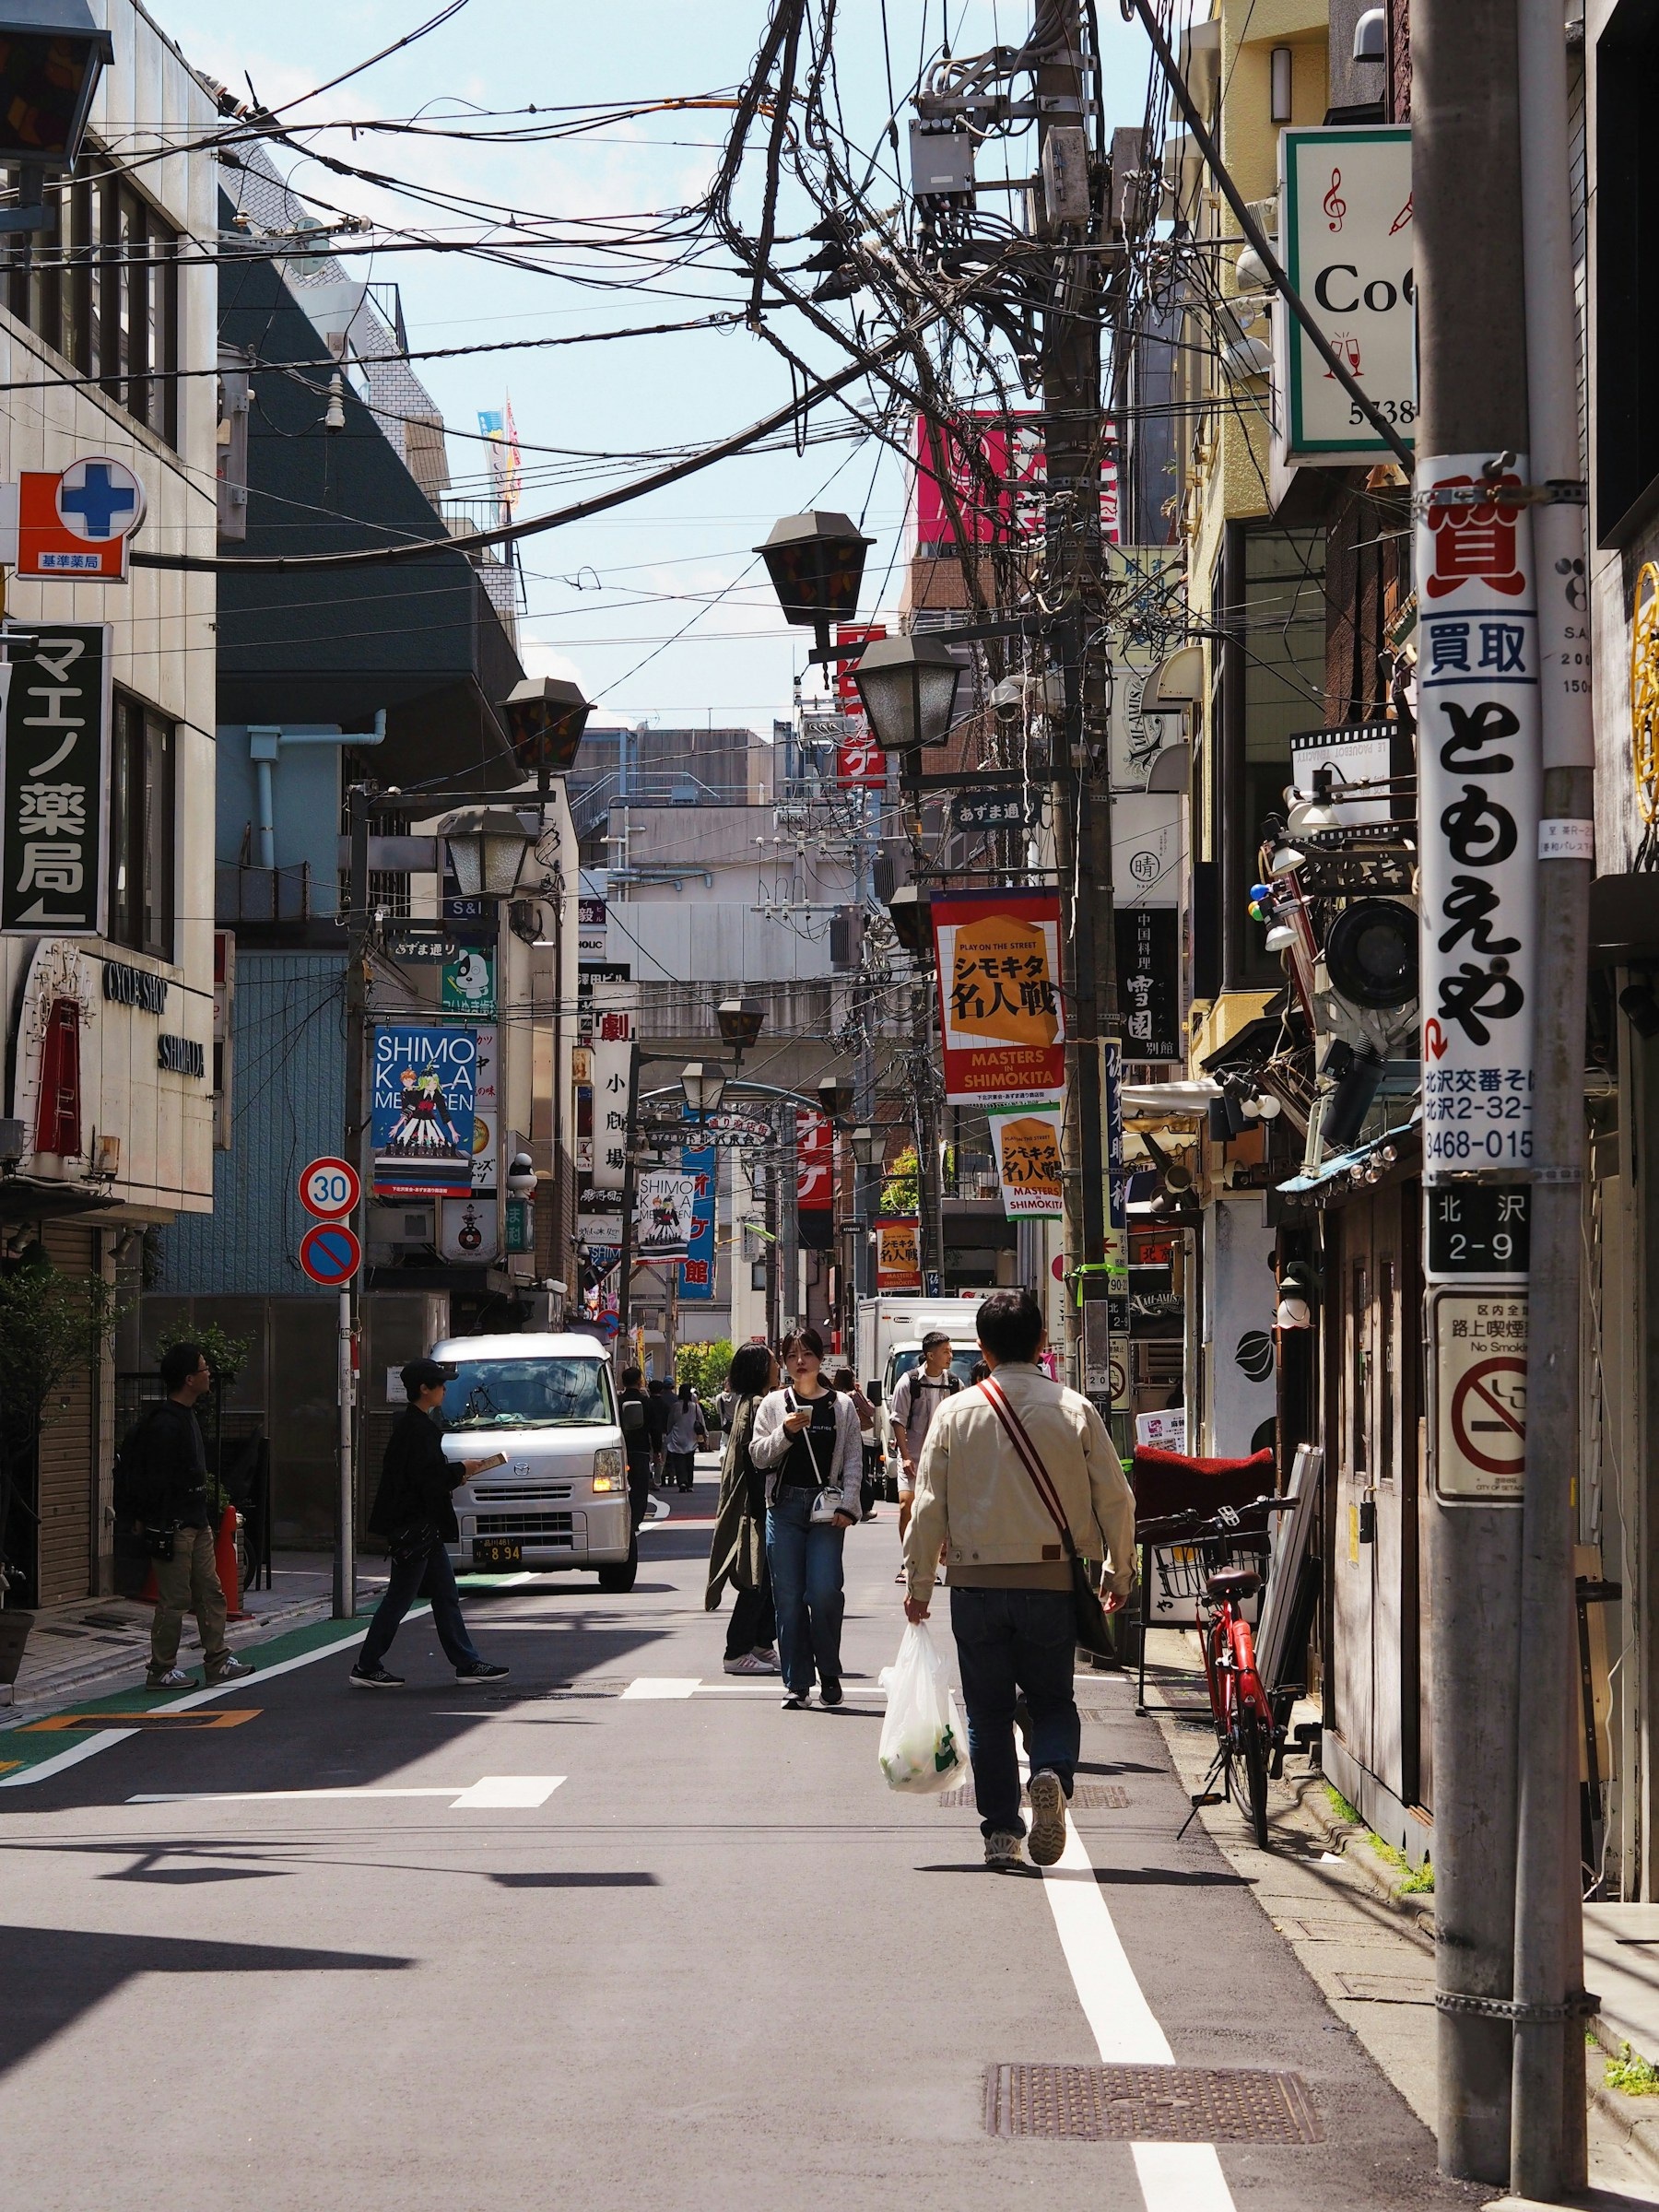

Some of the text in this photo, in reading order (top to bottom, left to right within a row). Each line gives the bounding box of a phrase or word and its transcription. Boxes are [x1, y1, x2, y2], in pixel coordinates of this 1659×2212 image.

[42, 555, 99, 569] 基準薬局
[1430, 622, 1525, 676] 買取
[17, 637, 86, 893] マエノ薬局
[1135, 861, 1155, 877] 晴
[1438, 701, 1524, 1046] ともえや
[395, 941, 455, 957] あずま通り
[1137, 913, 1151, 971] 中国料理
[955, 956, 1044, 980] シモキタ
[948, 981, 1058, 1019] 名人戦
[1126, 975, 1154, 1040] 雪園
[377, 1035, 476, 1064] SHIMO
[1146, 1041, 1173, 1055] 別館
[971, 1050, 1045, 1066] MASTERS
[965, 1071, 1054, 1088] SHIMOKITA
[1003, 1146, 1056, 1160] シモキタ
[313, 1175, 346, 1202] 30
[640, 1179, 694, 1194] SHIMO
[1014, 1187, 1059, 1196] MASTERS
[882, 1241, 914, 1249] シモキタ
[1449, 1234, 1512, 1260] 2-9
[880, 1249, 918, 1263] 名人戦
[1452, 1320, 1529, 1337] 路上喫煙
[1471, 1342, 1488, 1353] No
